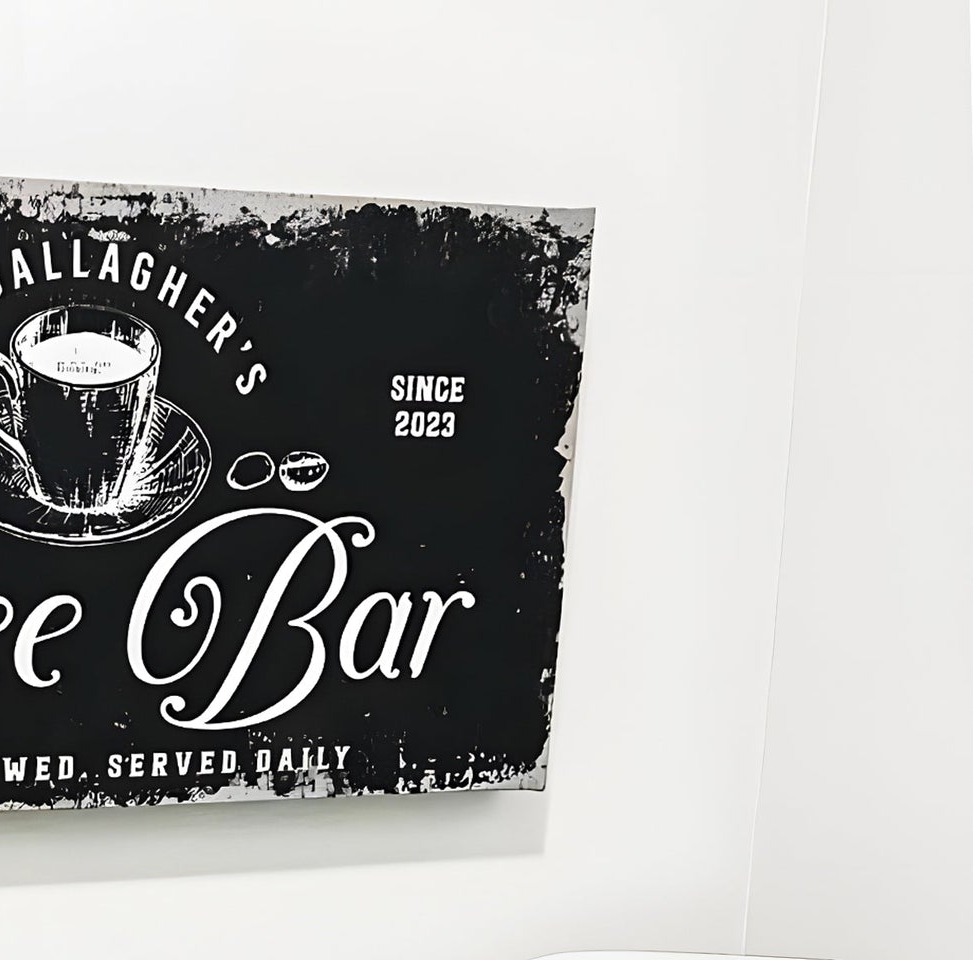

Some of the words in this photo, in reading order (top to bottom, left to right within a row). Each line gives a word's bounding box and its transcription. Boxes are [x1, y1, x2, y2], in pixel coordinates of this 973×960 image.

[390, 374, 465, 403] SINCE
[394, 410, 456, 438] 2023
[126, 507, 476, 731] Bar
[107, 750, 237, 778] SERVED
[256, 745, 351, 773] DAILY
